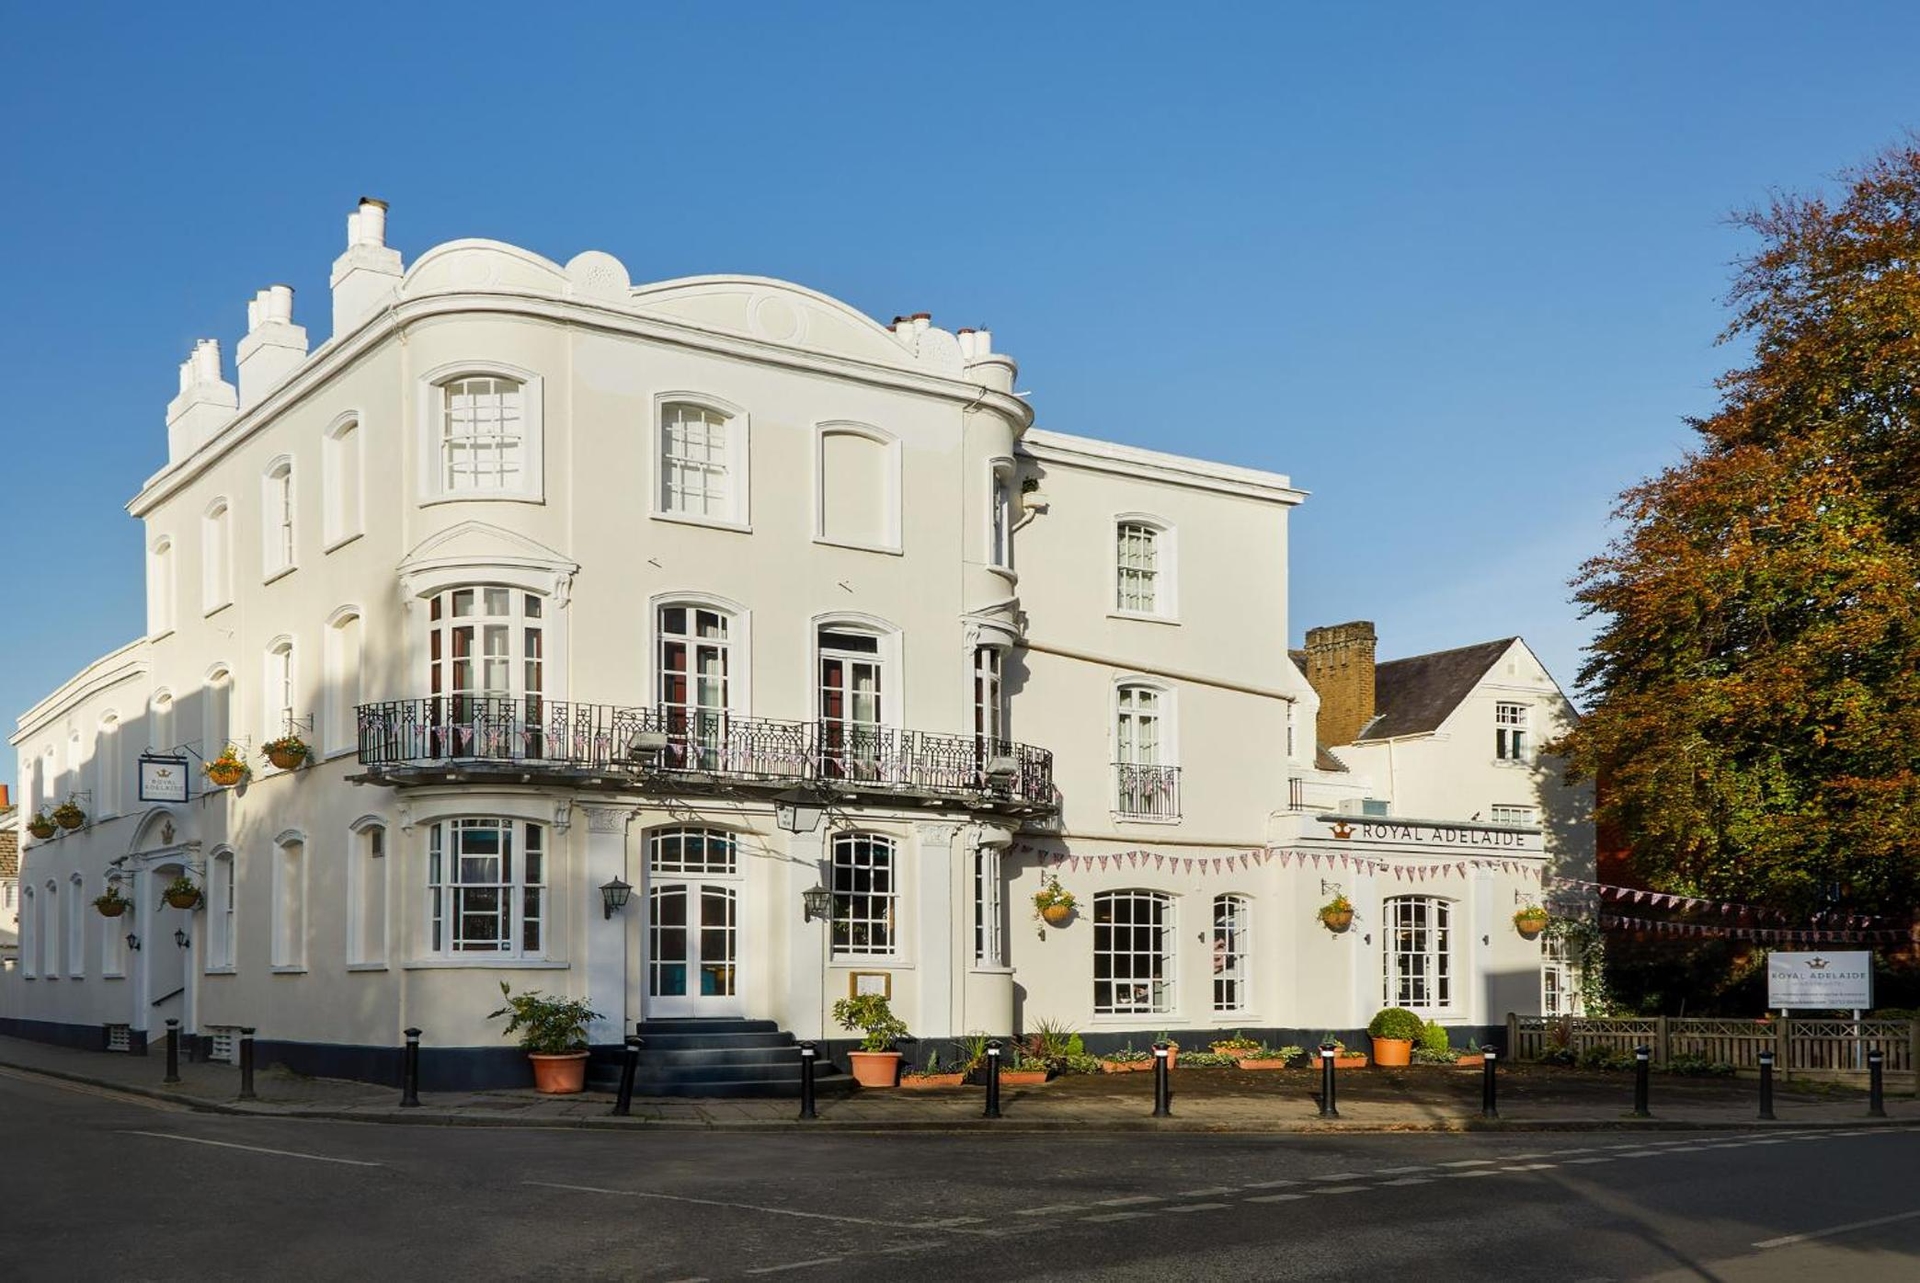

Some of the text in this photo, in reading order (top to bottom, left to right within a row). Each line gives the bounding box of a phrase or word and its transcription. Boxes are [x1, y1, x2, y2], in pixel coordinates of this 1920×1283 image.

[1363, 823, 1525, 847] ROYAL ADELAIDE
[1772, 972, 1866, 980] ROYAL ADELAIDE
